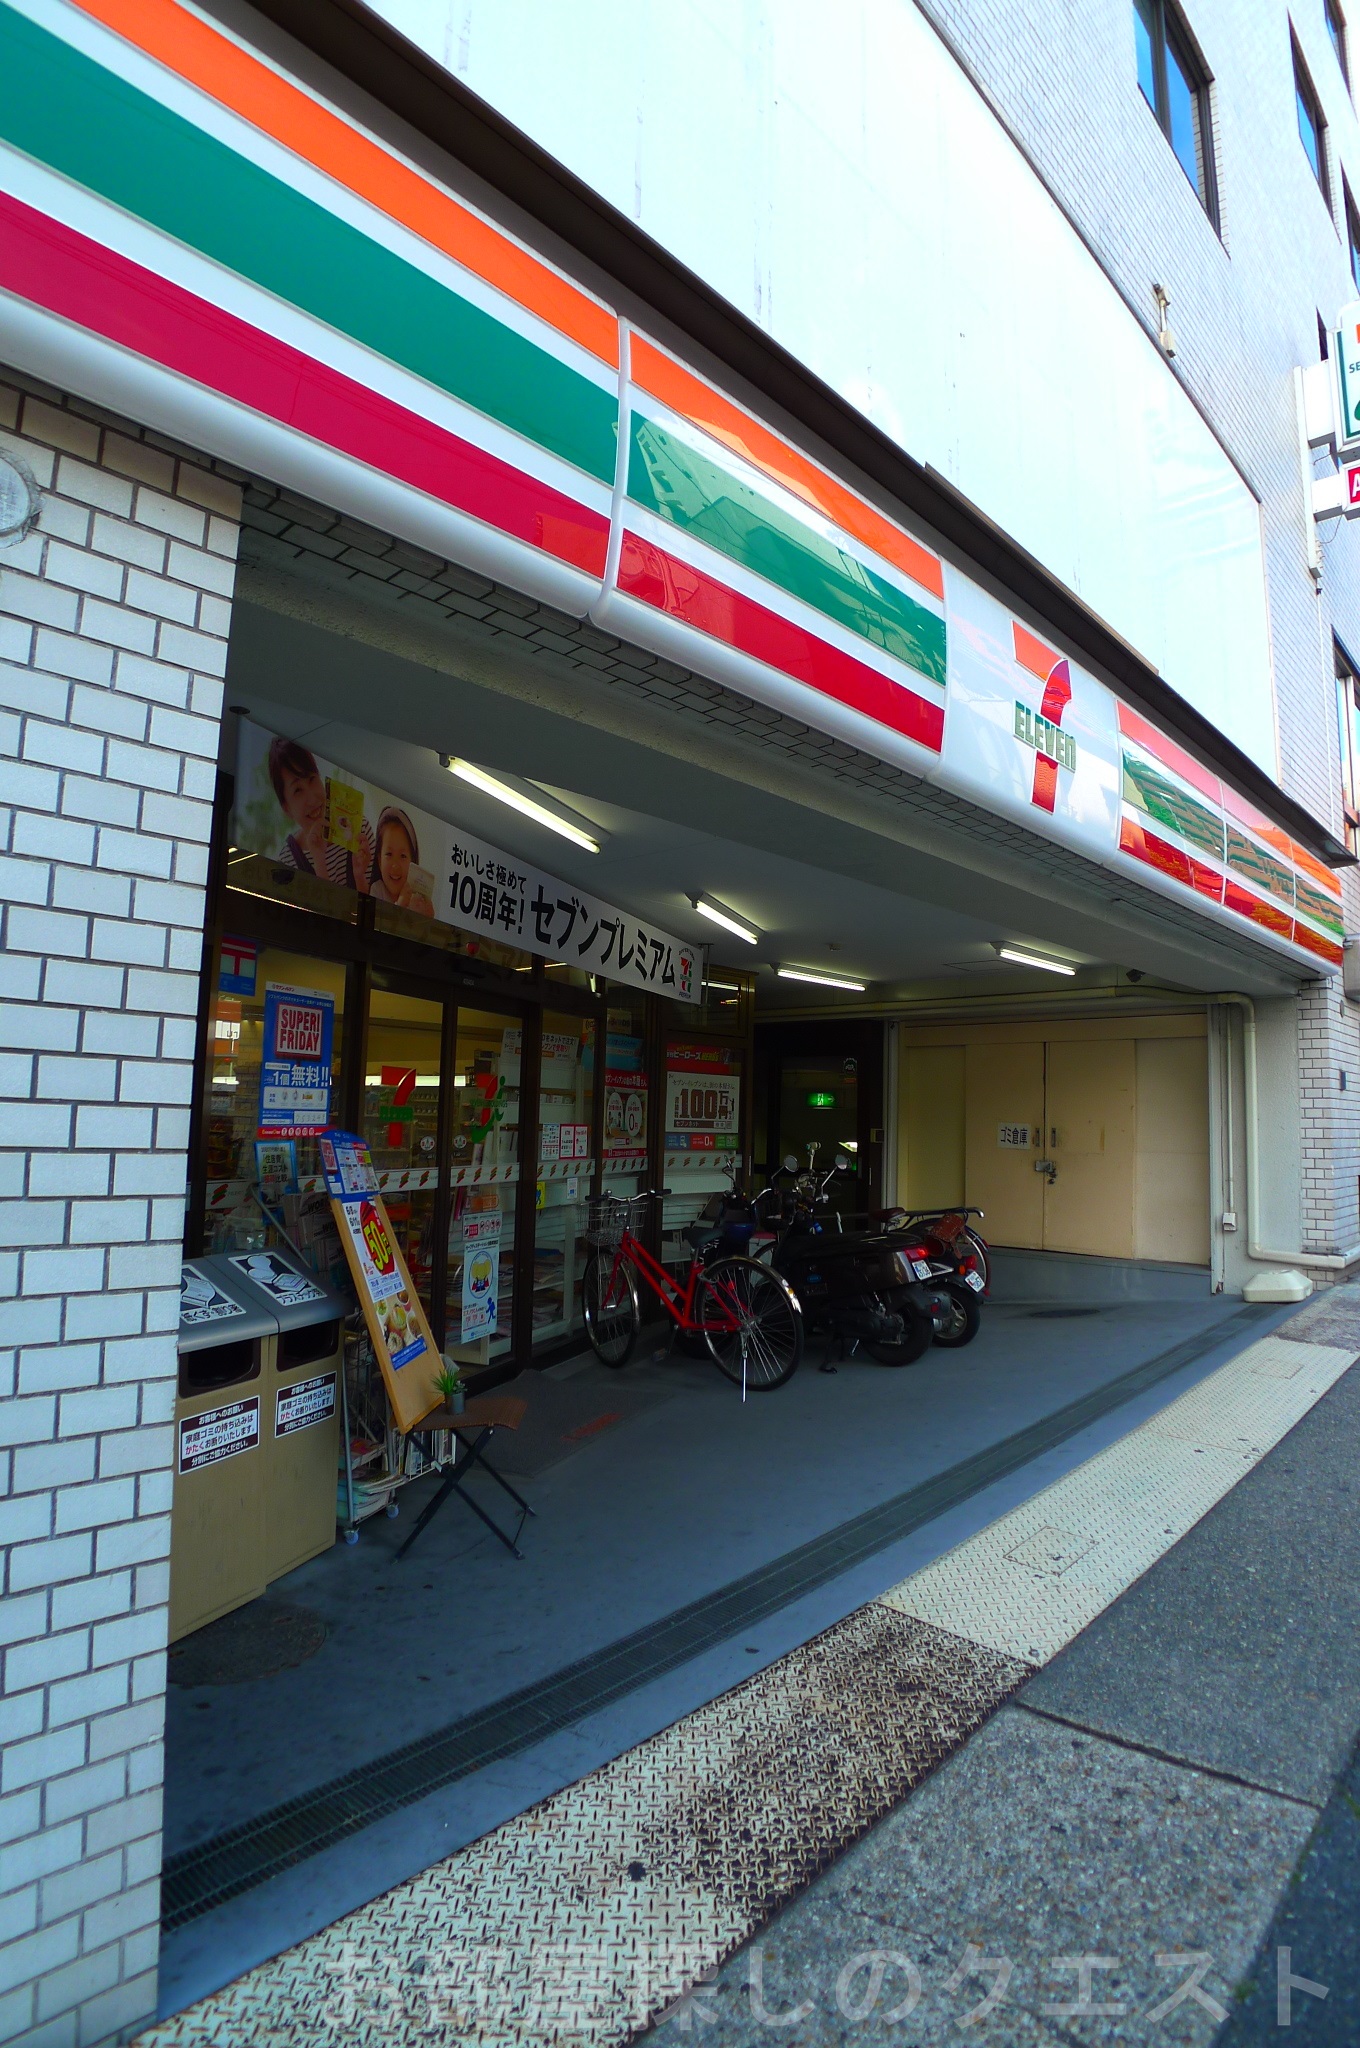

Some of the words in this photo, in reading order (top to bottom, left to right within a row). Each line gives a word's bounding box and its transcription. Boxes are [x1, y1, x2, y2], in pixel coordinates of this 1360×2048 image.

[451, 844, 527, 894] おいしさ極めて
[449, 871, 525, 934] 10周年!
[531, 884, 676, 987] セブンプレミアム
[280, 1029, 320, 1051] FRIDAY
[1000, 1127, 1028, 1145] ゴミ倉庫
[280, 1387, 332, 1411] 家庭ゴミの持ち込みは
[280, 1397, 333, 1421] かたくお断りいたします。
[185, 1414, 254, 1445] 家庭ゴミの持ち込みは
[185, 1425, 255, 1455] かたくお断りいたします。
